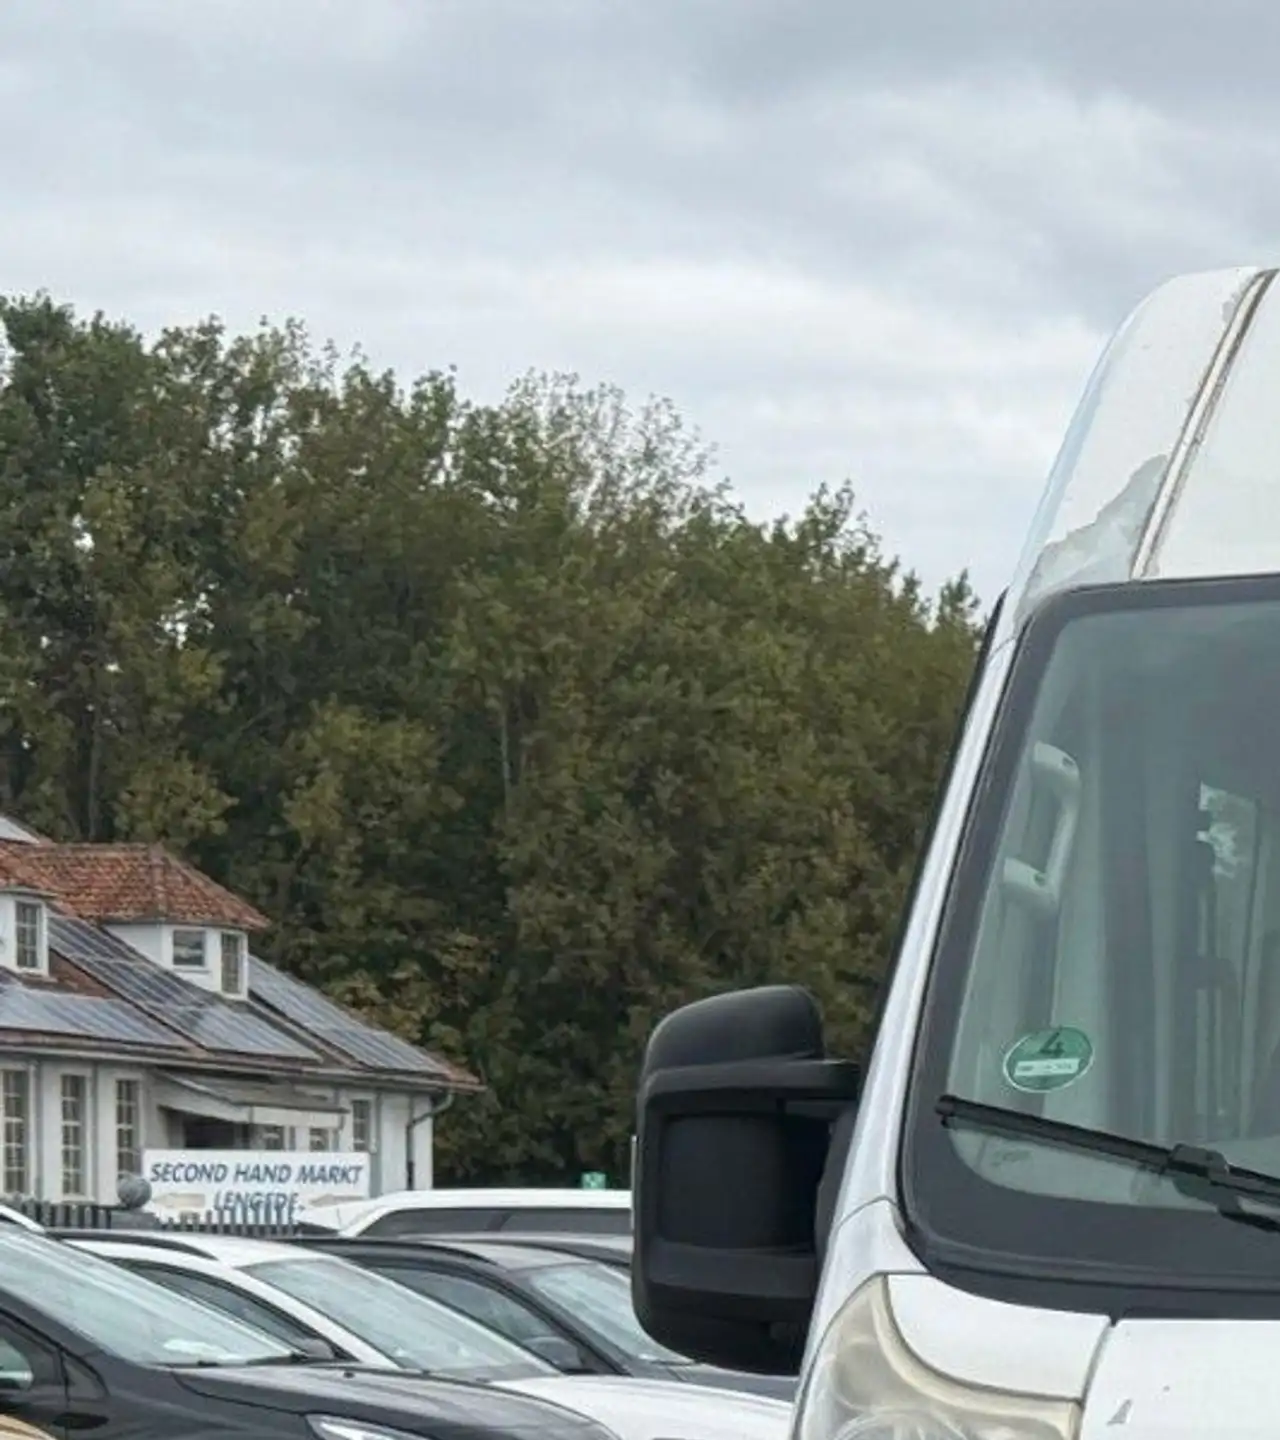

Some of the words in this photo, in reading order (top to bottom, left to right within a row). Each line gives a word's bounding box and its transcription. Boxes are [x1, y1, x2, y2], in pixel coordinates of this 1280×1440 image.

[1039, 1030, 1065, 1057] 4
[150, 1163, 227, 1183] SECOND
[233, 1163, 292, 1184] HAND
[296, 1165, 363, 1184] MARKT
